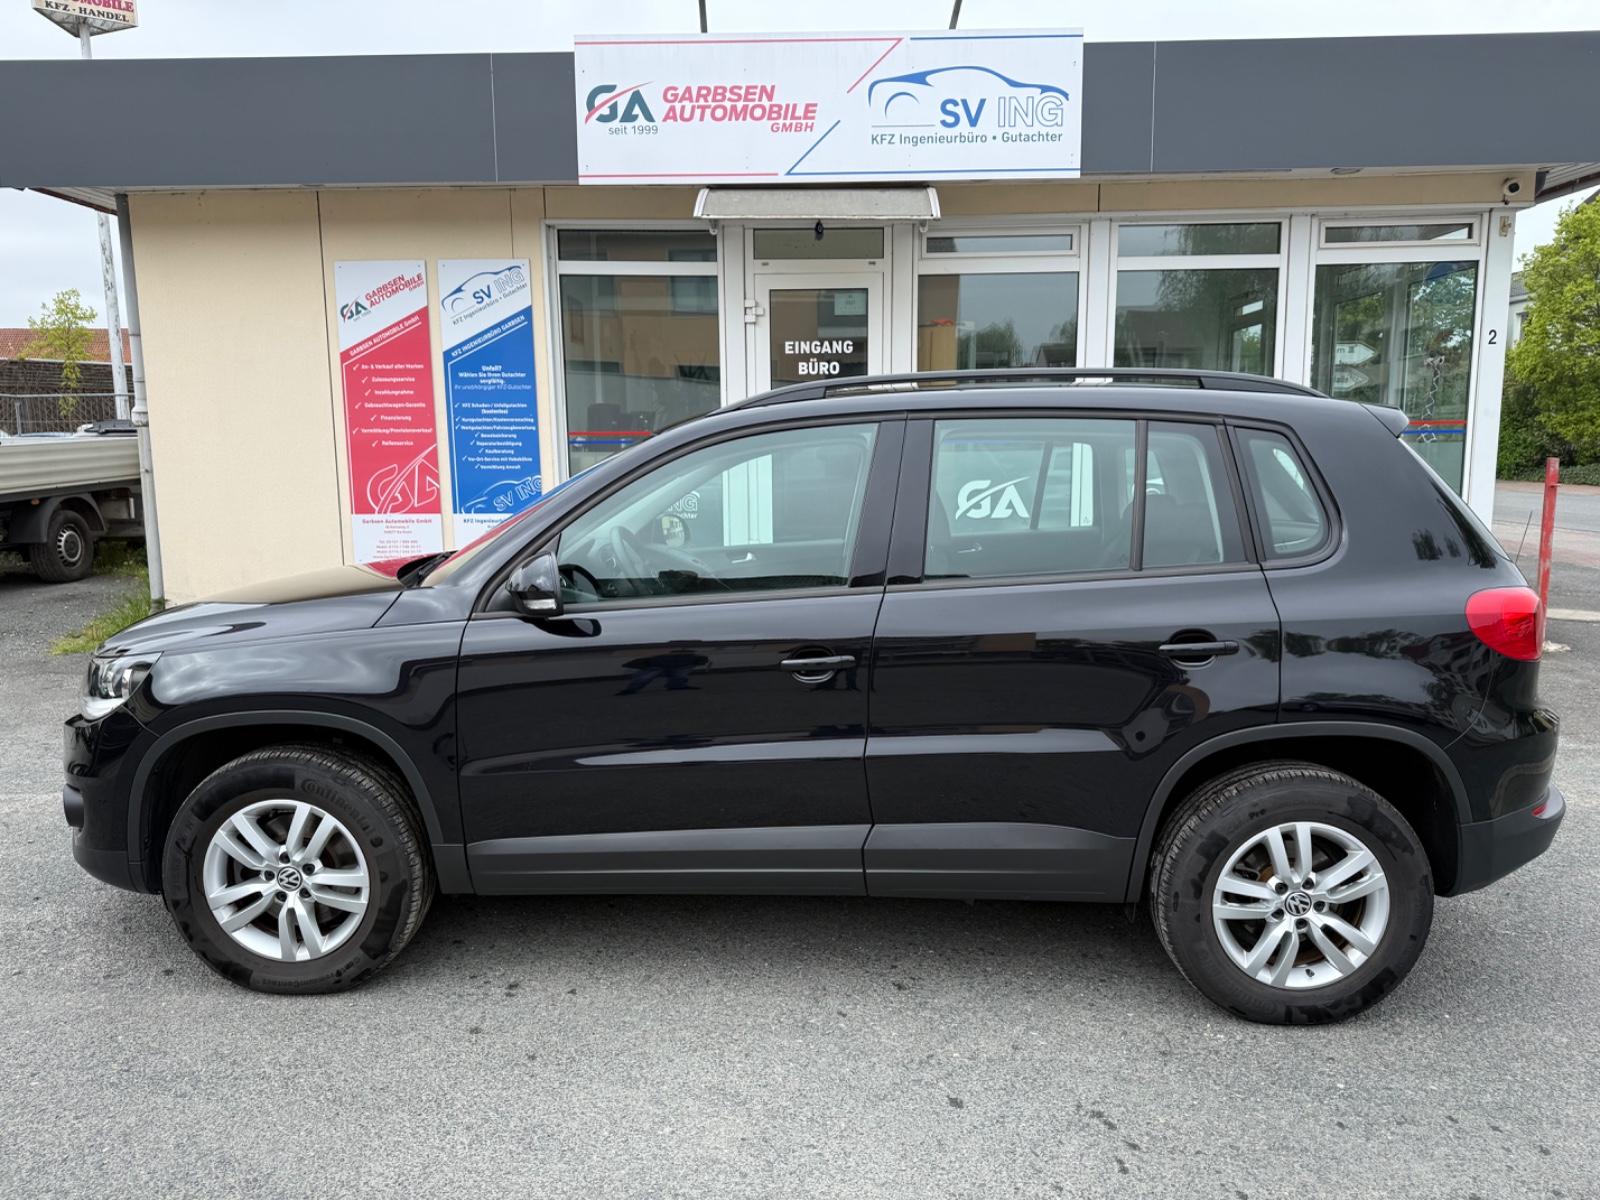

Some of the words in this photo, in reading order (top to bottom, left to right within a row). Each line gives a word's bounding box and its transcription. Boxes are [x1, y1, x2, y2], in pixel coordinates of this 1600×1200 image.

[45, 1, 70, 12] KFZ
[79, 6, 130, 22] HANDEL
[662, 85, 776, 103] GARBSEN
[662, 103, 818, 122] AUTOMOBILE
[940, 98, 987, 128] SV
[998, 95, 1064, 128] ING
[609, 125, 627, 135] seit
[632, 125, 658, 135] 1999
[770, 122, 815, 133] GMBH
[871, 134, 896, 145] KFZ
[899, 132, 988, 147] Ingenieurbüro
[1001, 131, 1063, 144] Gutachter
[365, 274, 405, 301] GARBSEN
[370, 273, 423, 308] AUTOMOBILE
[472, 284, 492, 304] SV
[494, 269, 525, 294] ING
[1488, 329, 1497, 345] 2
[784, 340, 853, 354] EINGANG
[798, 358, 840, 375] BÜRO
[493, 490, 514, 512] SV
